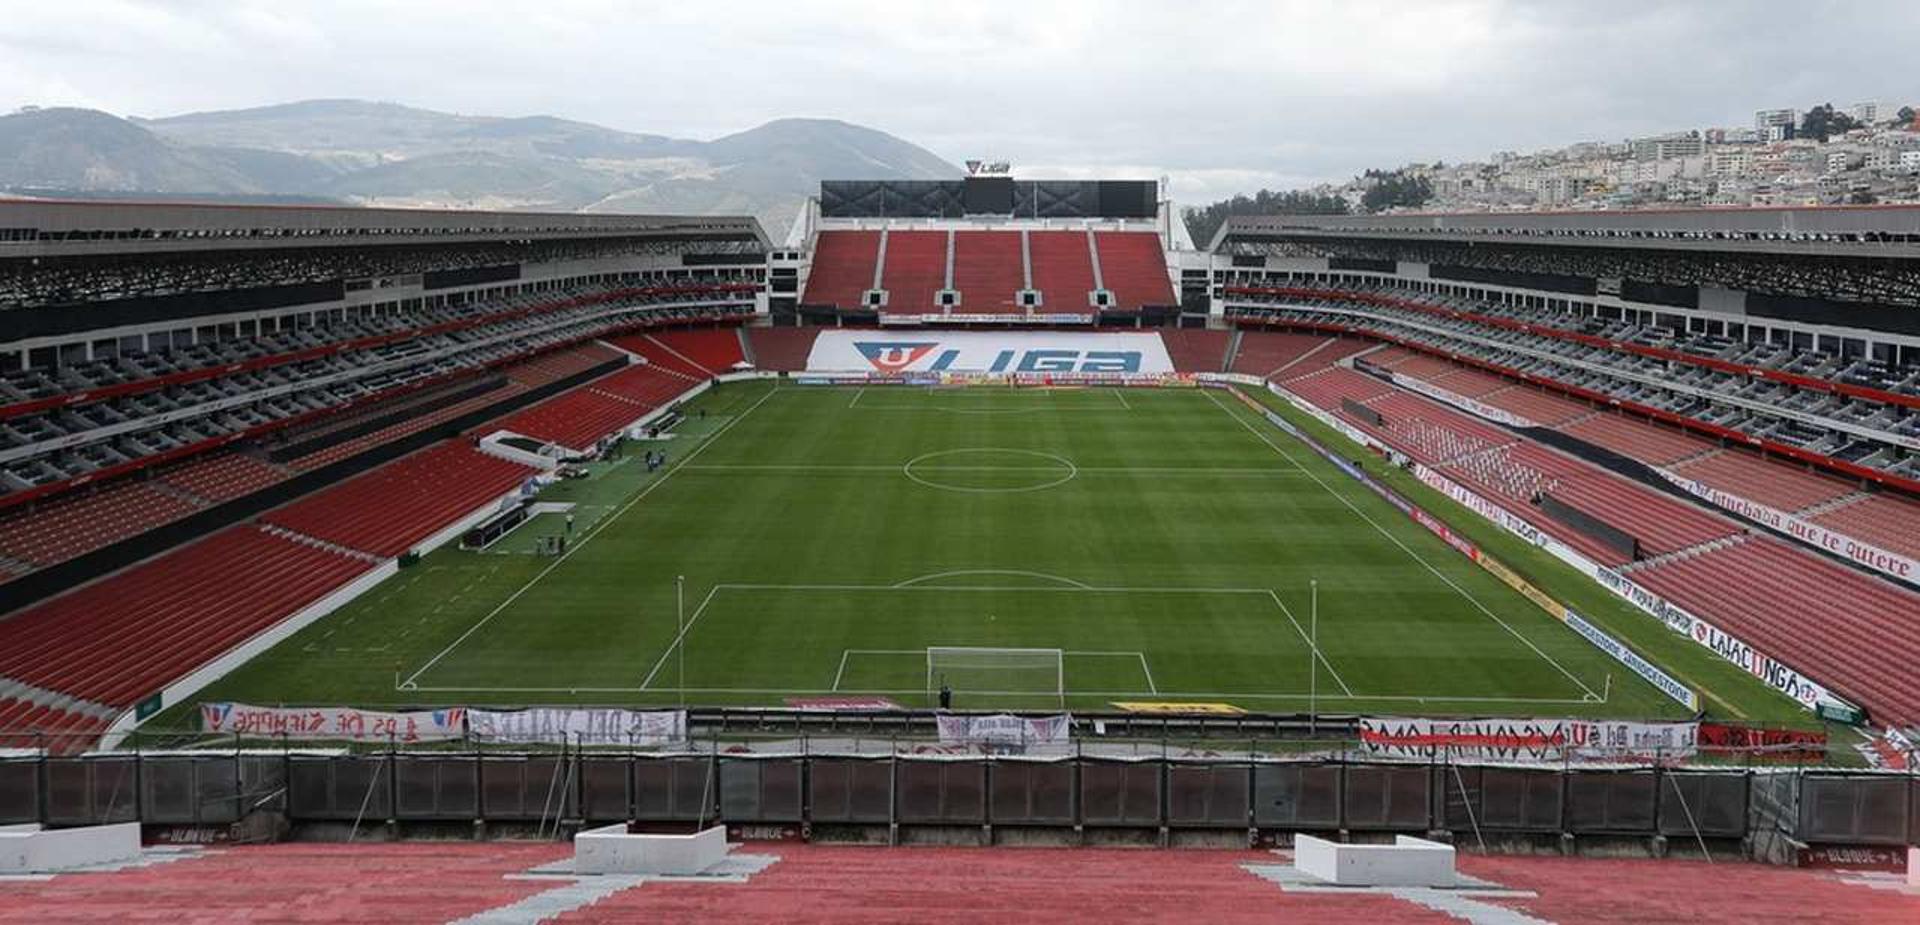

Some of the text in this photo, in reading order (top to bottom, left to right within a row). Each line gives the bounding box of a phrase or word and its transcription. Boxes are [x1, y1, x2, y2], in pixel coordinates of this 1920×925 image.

[1848, 541, 1911, 576] quiere
[1566, 609, 1622, 656] BRIDGESTONE
[1623, 649, 1692, 704] BRIDGESTONE
